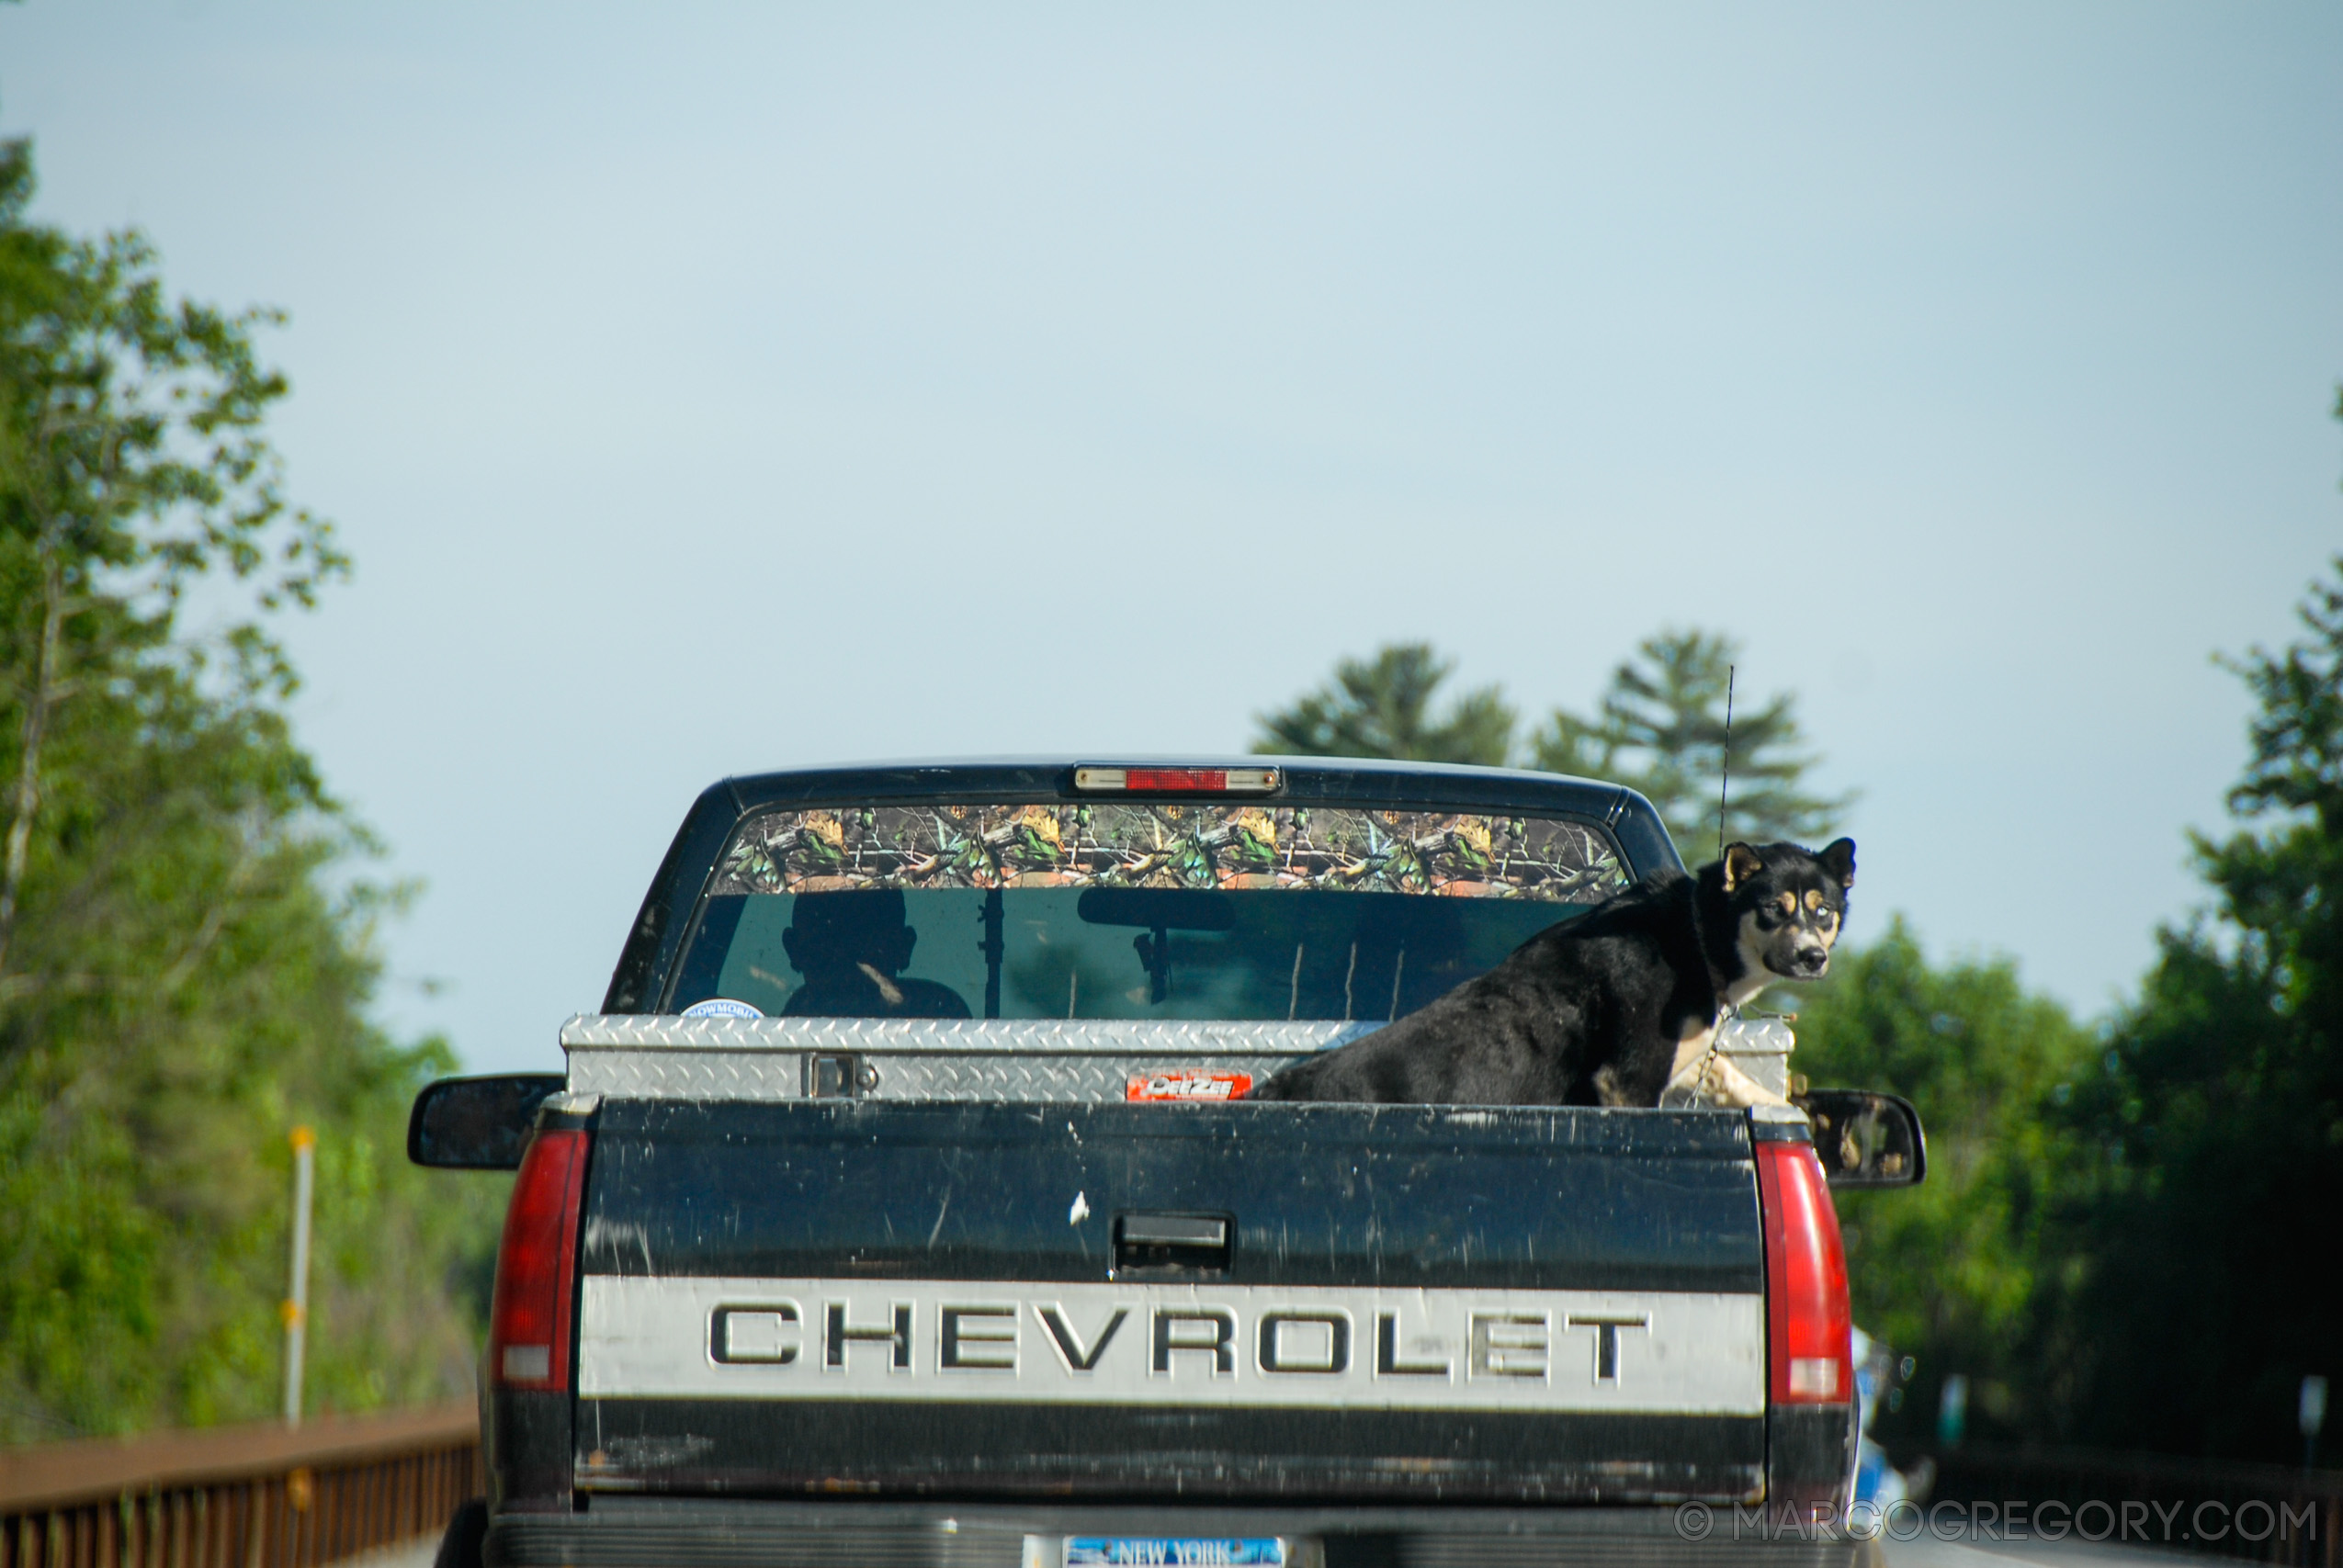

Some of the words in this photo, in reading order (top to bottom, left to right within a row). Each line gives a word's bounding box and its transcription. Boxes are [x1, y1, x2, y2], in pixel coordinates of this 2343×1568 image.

[704, 1296, 1651, 1388] CHEVROLET
[1119, 1540, 1167, 1565] NEW
[1174, 1540, 1232, 1565] YORK
